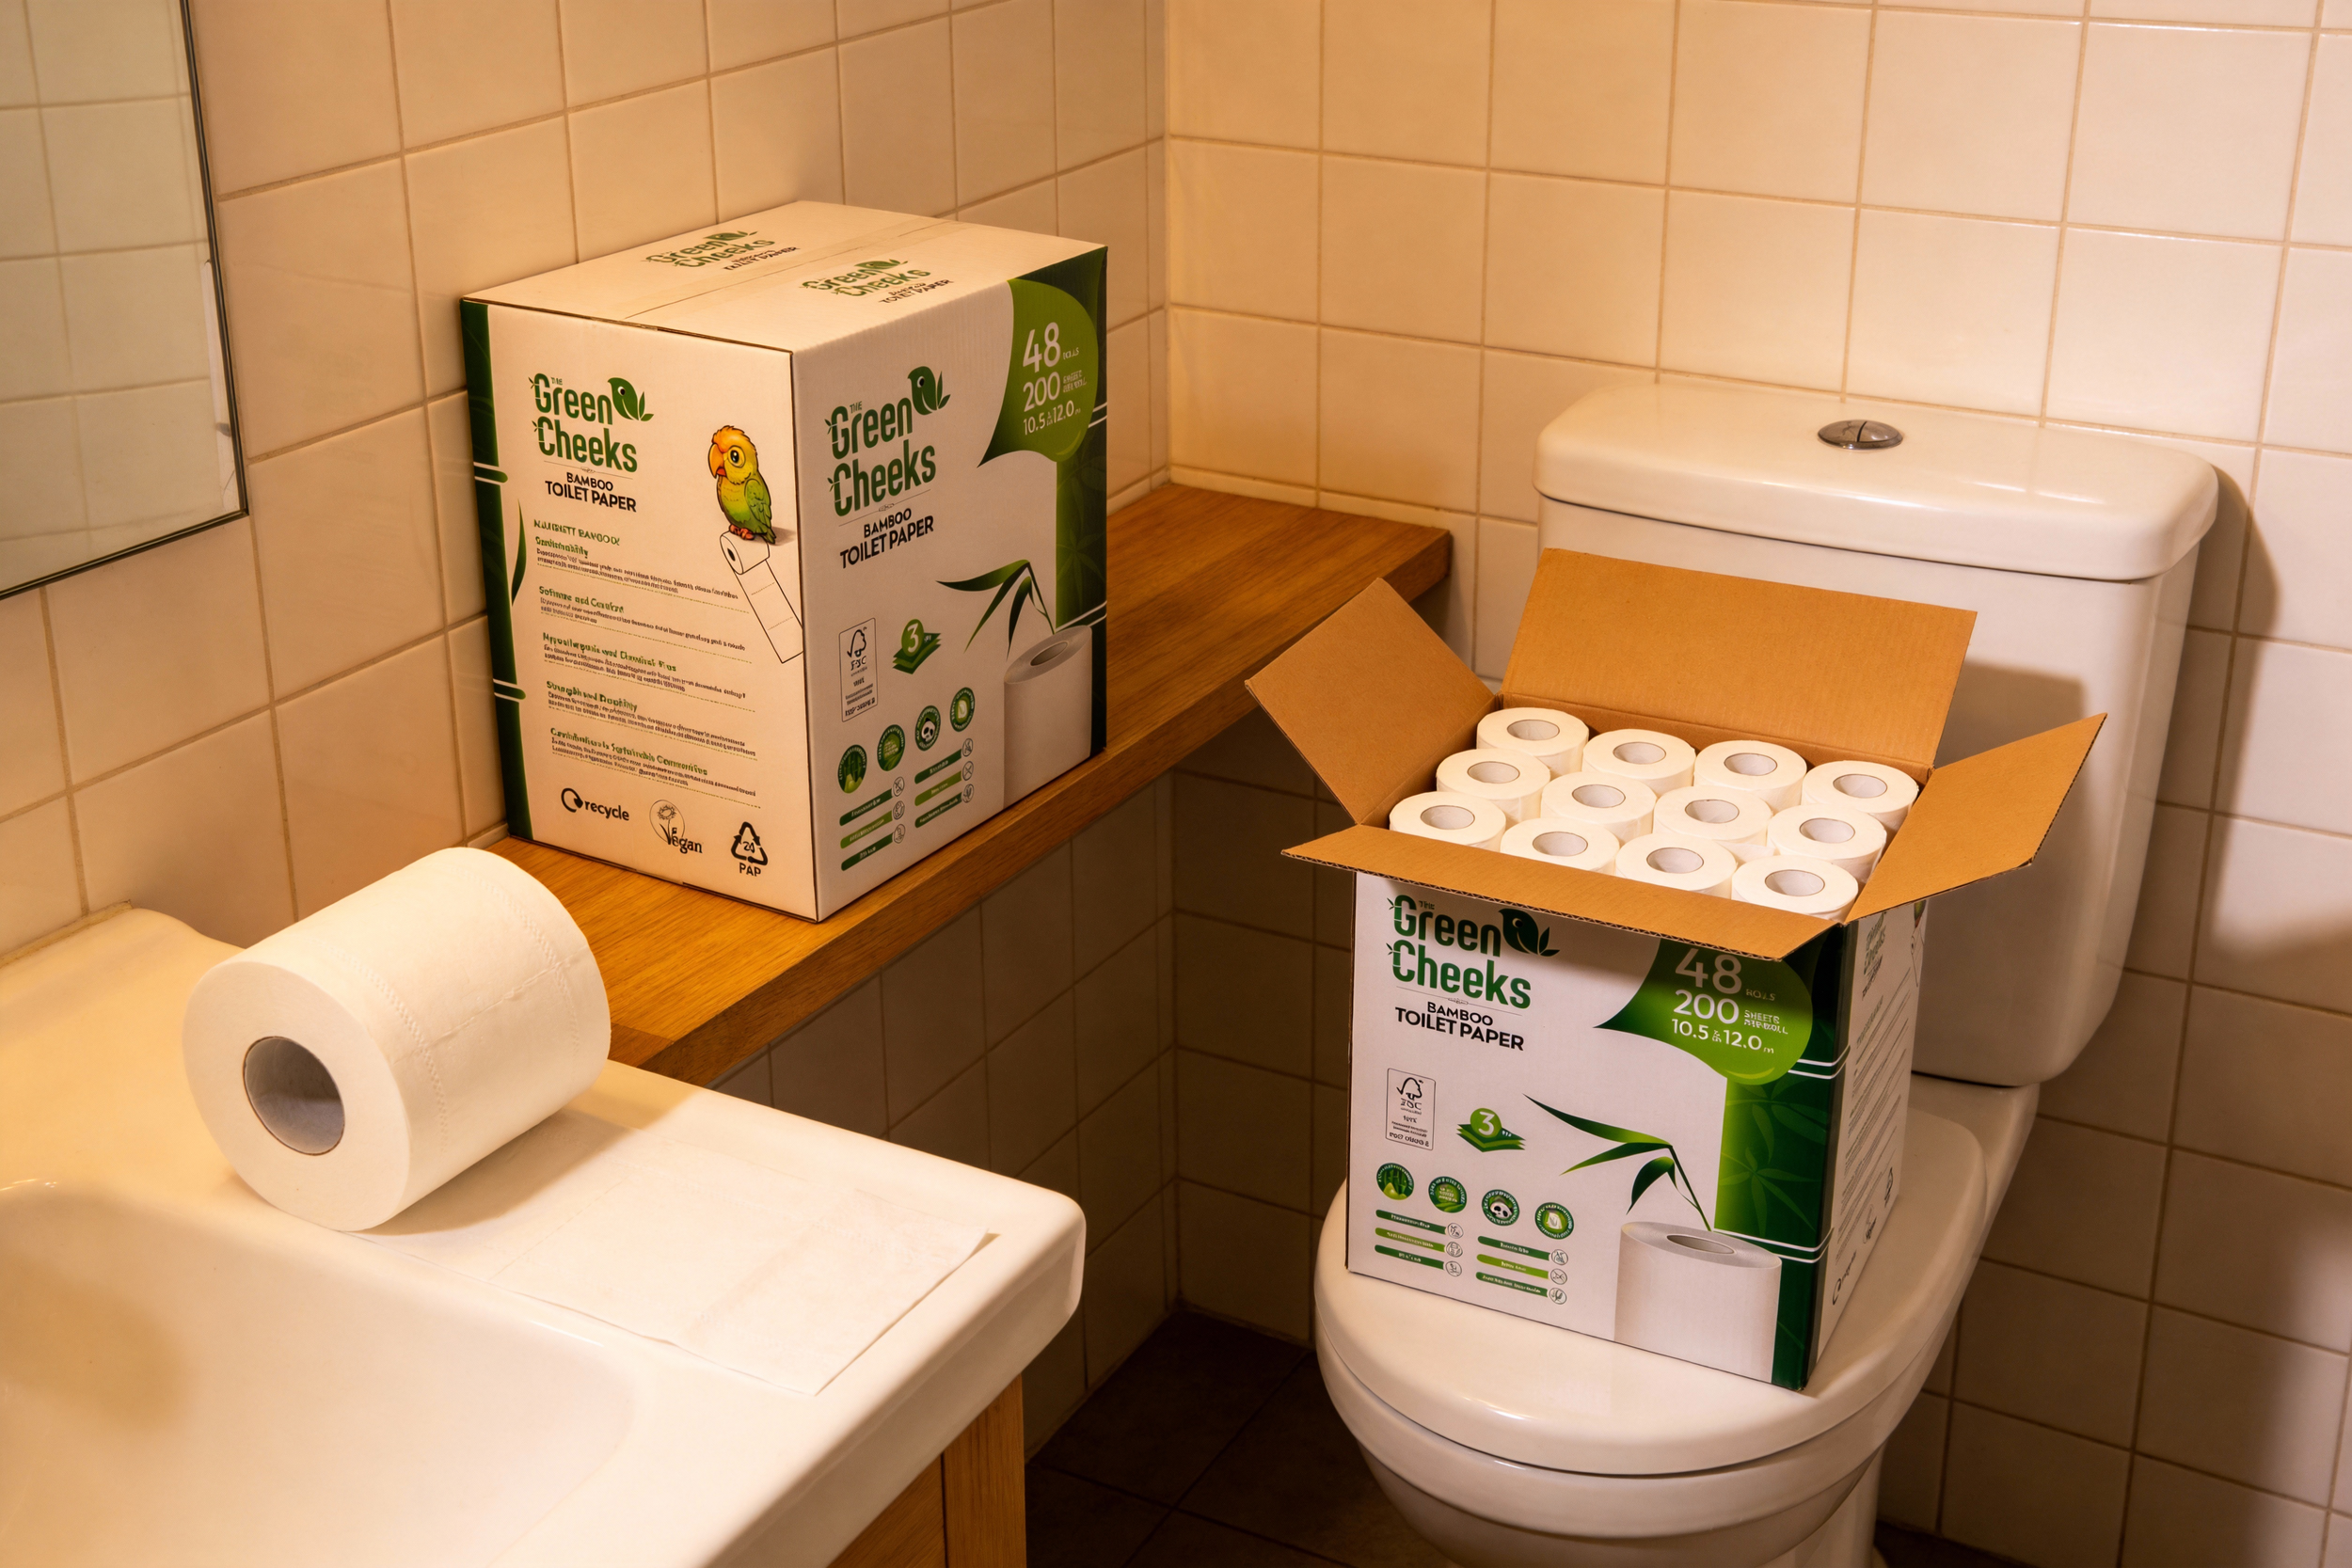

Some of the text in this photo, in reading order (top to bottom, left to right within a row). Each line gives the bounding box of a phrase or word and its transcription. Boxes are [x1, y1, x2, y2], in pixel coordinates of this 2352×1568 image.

[645, 240, 728, 263] Green
[676, 240, 775, 268] Cheeks
[803, 269, 883, 291] Green
[834, 269, 931, 296] Cheeks
[1023, 322, 1061, 373] 48
[533, 372, 613, 425] Green
[1023, 372, 1060, 412] 200
[831, 397, 913, 460] Green
[1023, 412, 1046, 436] 10.5
[1053, 400, 1074, 423] 12.0
[536, 416, 638, 473] Cheeks
[566, 472, 613, 491] BAMBOO
[834, 438, 936, 517] Cheeks
[545, 480, 637, 513] TOILET PAPER
[864, 508, 912, 539] BAMBOO
[839, 515, 934, 569] TOILET PAPER
[907, 623, 919, 653] 3
[584, 800, 629, 821] recycle
[739, 863, 761, 877] PAP
[1393, 895, 1502, 958] Green
[1392, 939, 1532, 1009] Cheeks
[1675, 947, 1742, 994] 48
[1427, 1001, 1493, 1026] BAMBOO
[1674, 990, 1740, 1024] 200
[1395, 1006, 1524, 1052] TOILET PAPER
[1671, 1019, 1708, 1040] 10.5
[1724, 1029, 1762, 1051] 12.0
[1478, 1111, 1495, 1135] 3
